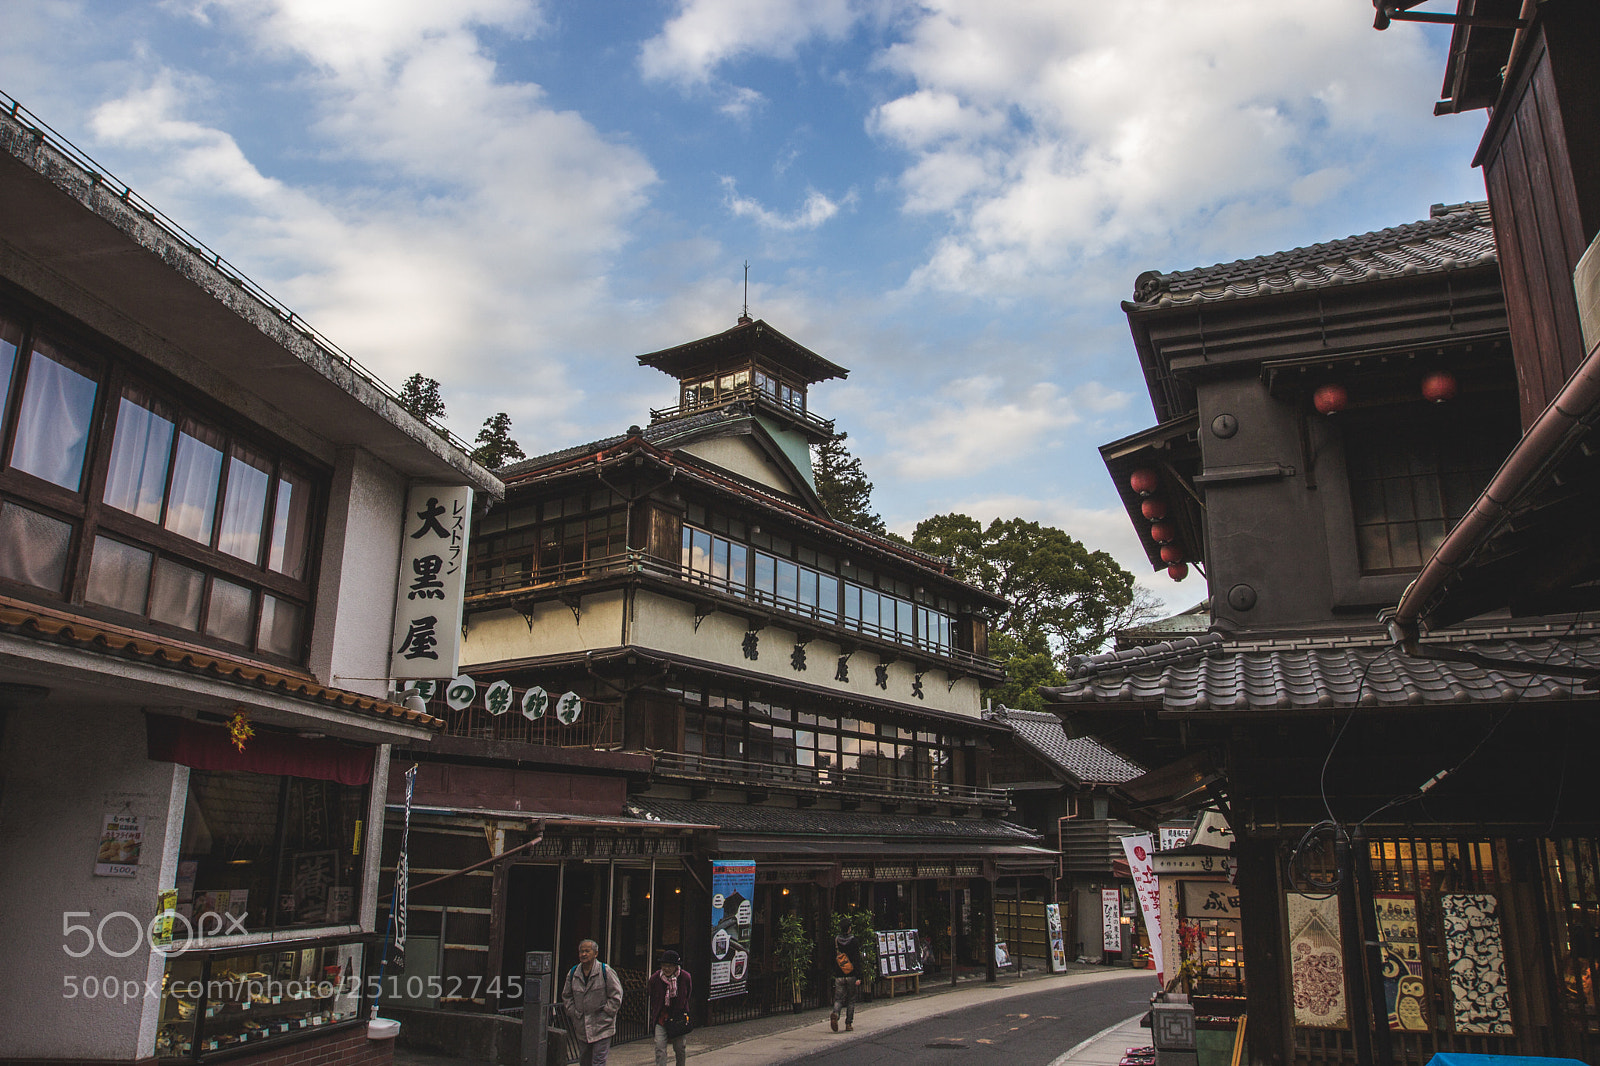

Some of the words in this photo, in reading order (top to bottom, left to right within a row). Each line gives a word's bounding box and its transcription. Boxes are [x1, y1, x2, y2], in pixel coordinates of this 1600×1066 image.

[397, 497, 451, 661] 大黒屋
[447, 500, 464, 575] レストラン
